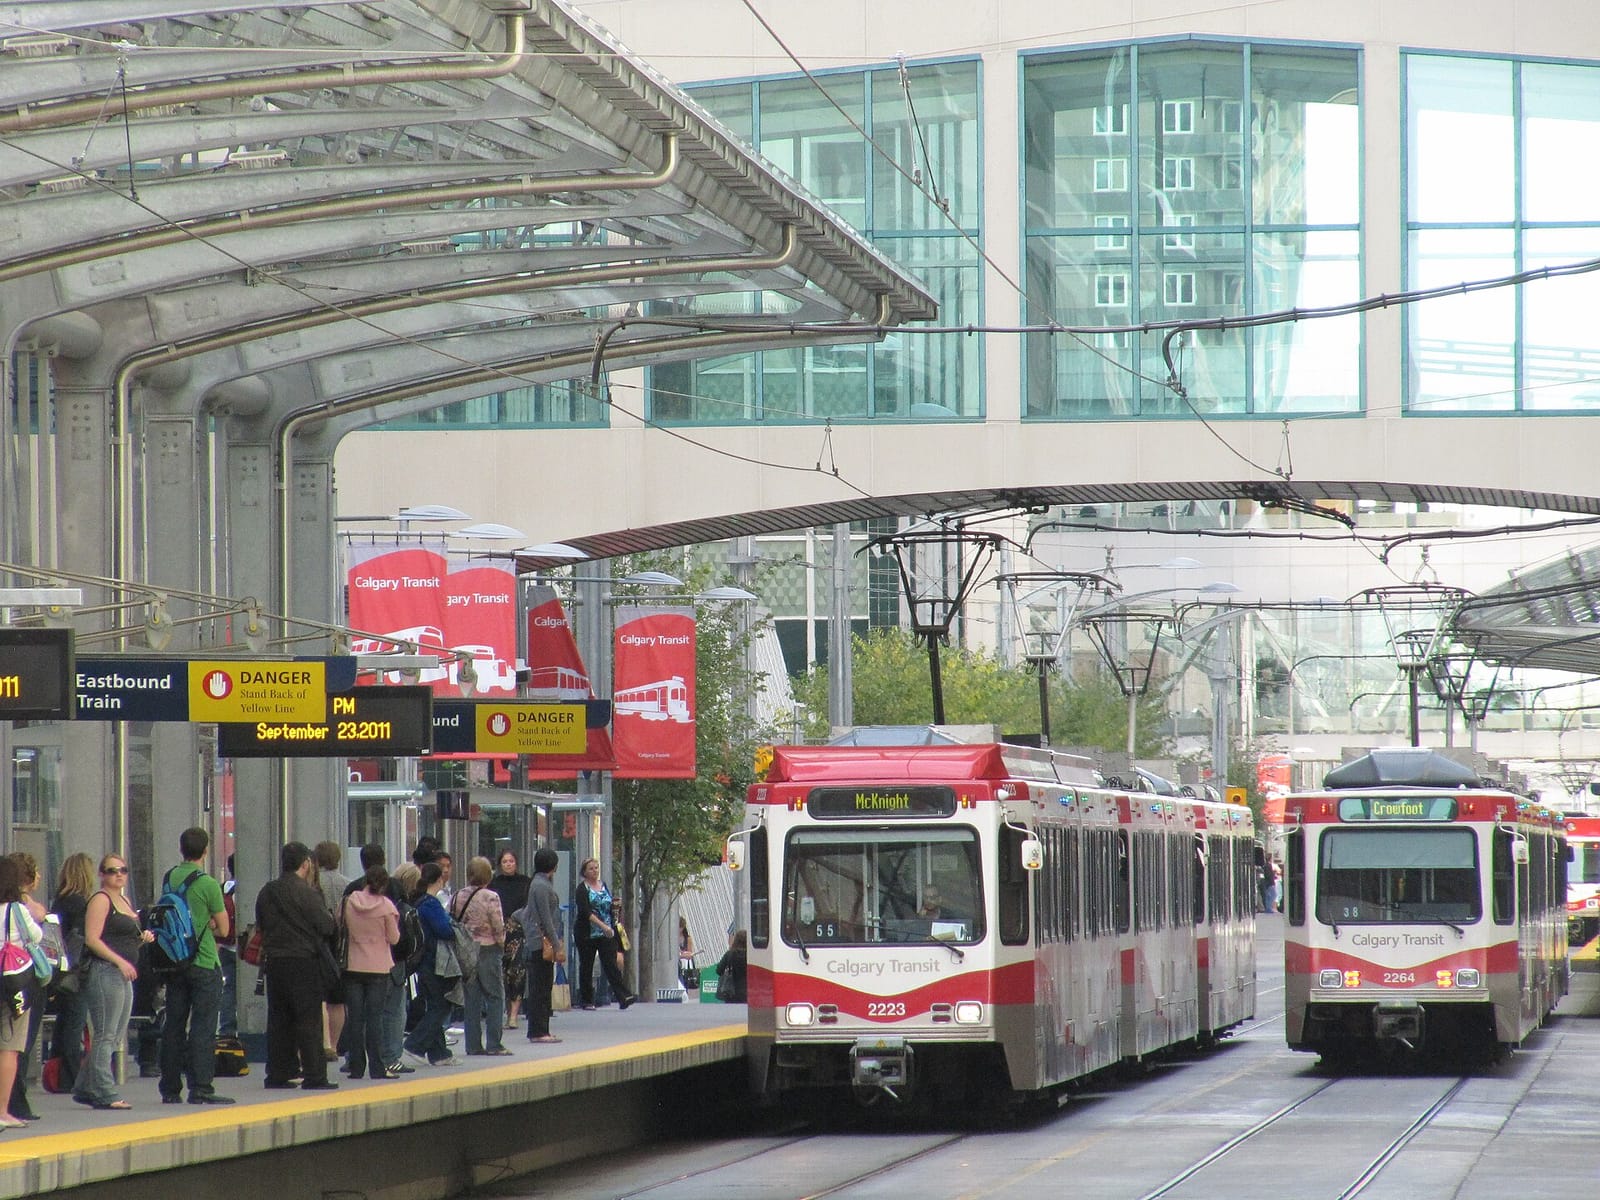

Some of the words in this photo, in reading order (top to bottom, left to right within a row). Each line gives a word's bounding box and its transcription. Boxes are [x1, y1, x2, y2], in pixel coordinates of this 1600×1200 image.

[354, 576, 399, 591] Calgary
[402, 576, 440, 588] Transit
[472, 593, 509, 604] Transit
[620, 634, 656, 646] Calgary
[658, 634, 690, 645] Transit
[75, 673, 171, 689] Eastbound
[240, 671, 312, 685] DANGER
[240, 688, 267, 699] Stand
[269, 688, 293, 699] Back
[296, 688, 307, 699] of
[77, 694, 121, 709] Train
[240, 703, 272, 714] Yellow
[275, 703, 295, 714] Line
[333, 698, 355, 715] PM
[432, 714, 459, 727] und
[517, 712, 575, 723] DANGER
[257, 722, 329, 740] September
[337, 722, 391, 740] 23,2011
[517, 726, 539, 735] Stand
[541, 726, 561, 735] Back
[562, 726, 571, 735] of
[517, 738, 543, 747] Yellow
[545, 738, 561, 747] Line
[855, 792, 910, 811] McKnight
[1373, 801, 1424, 816] Crowfoot
[1352, 933, 1400, 948] Calgary
[1402, 933, 1444, 946] Transit
[826, 959, 885, 977] Calgary
[889, 958, 941, 973] Transit
[1383, 972, 1416, 983] 2264
[867, 1002, 906, 1016] 2223
